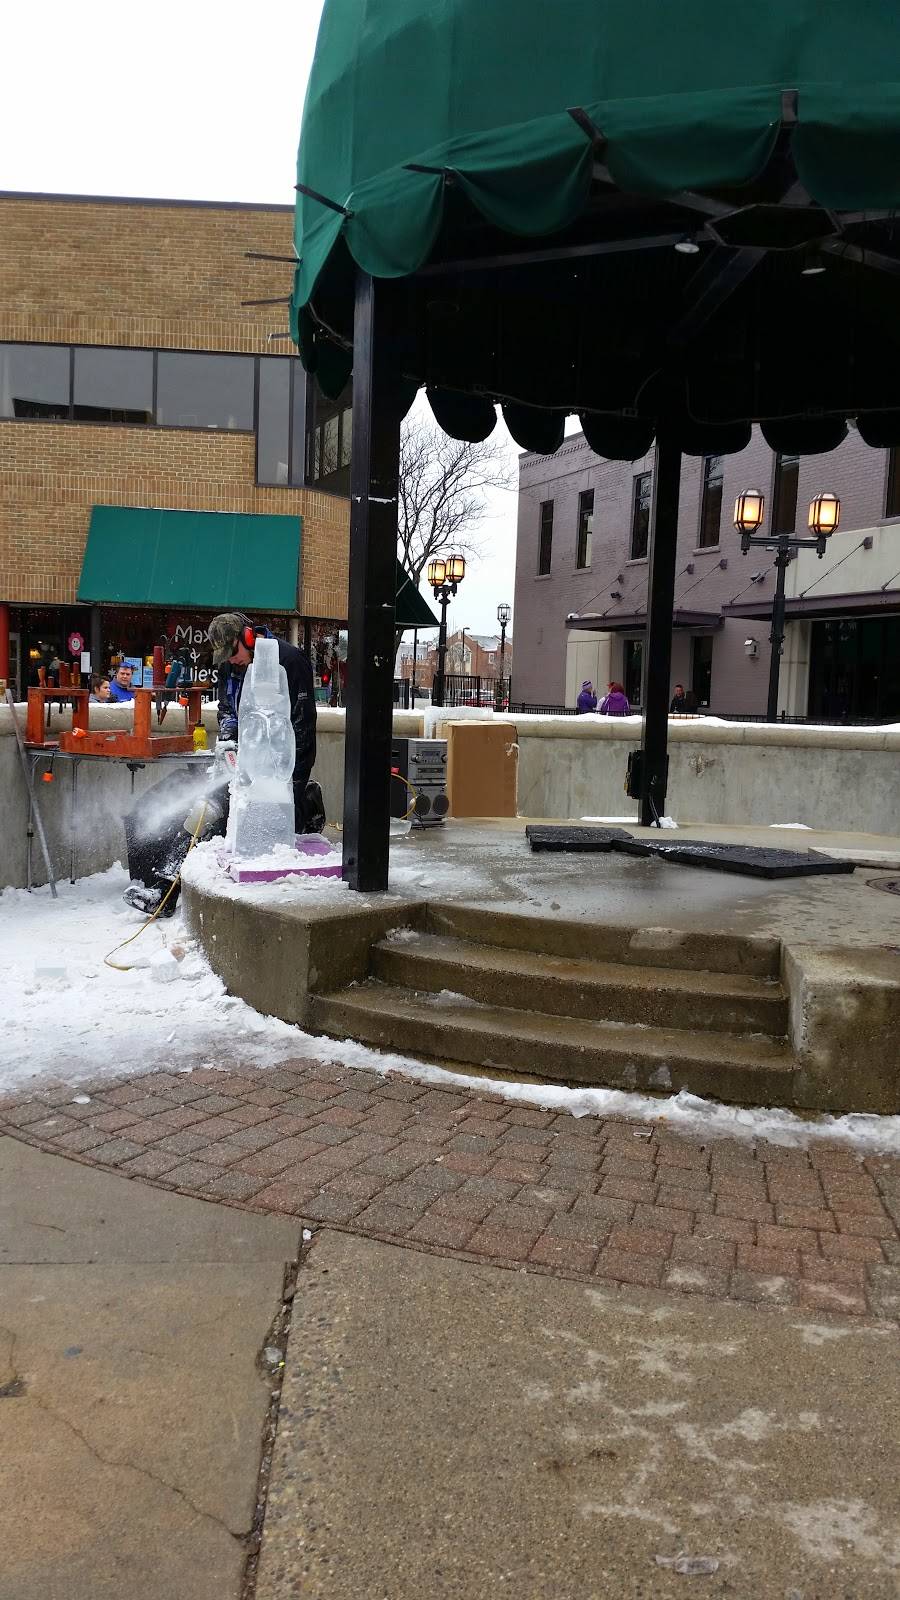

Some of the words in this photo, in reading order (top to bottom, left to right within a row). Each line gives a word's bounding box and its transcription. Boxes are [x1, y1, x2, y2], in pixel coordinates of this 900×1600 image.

[175, 625, 210, 645] Max
[190, 647, 201, 663] &
[190, 665, 219, 683] lie's
